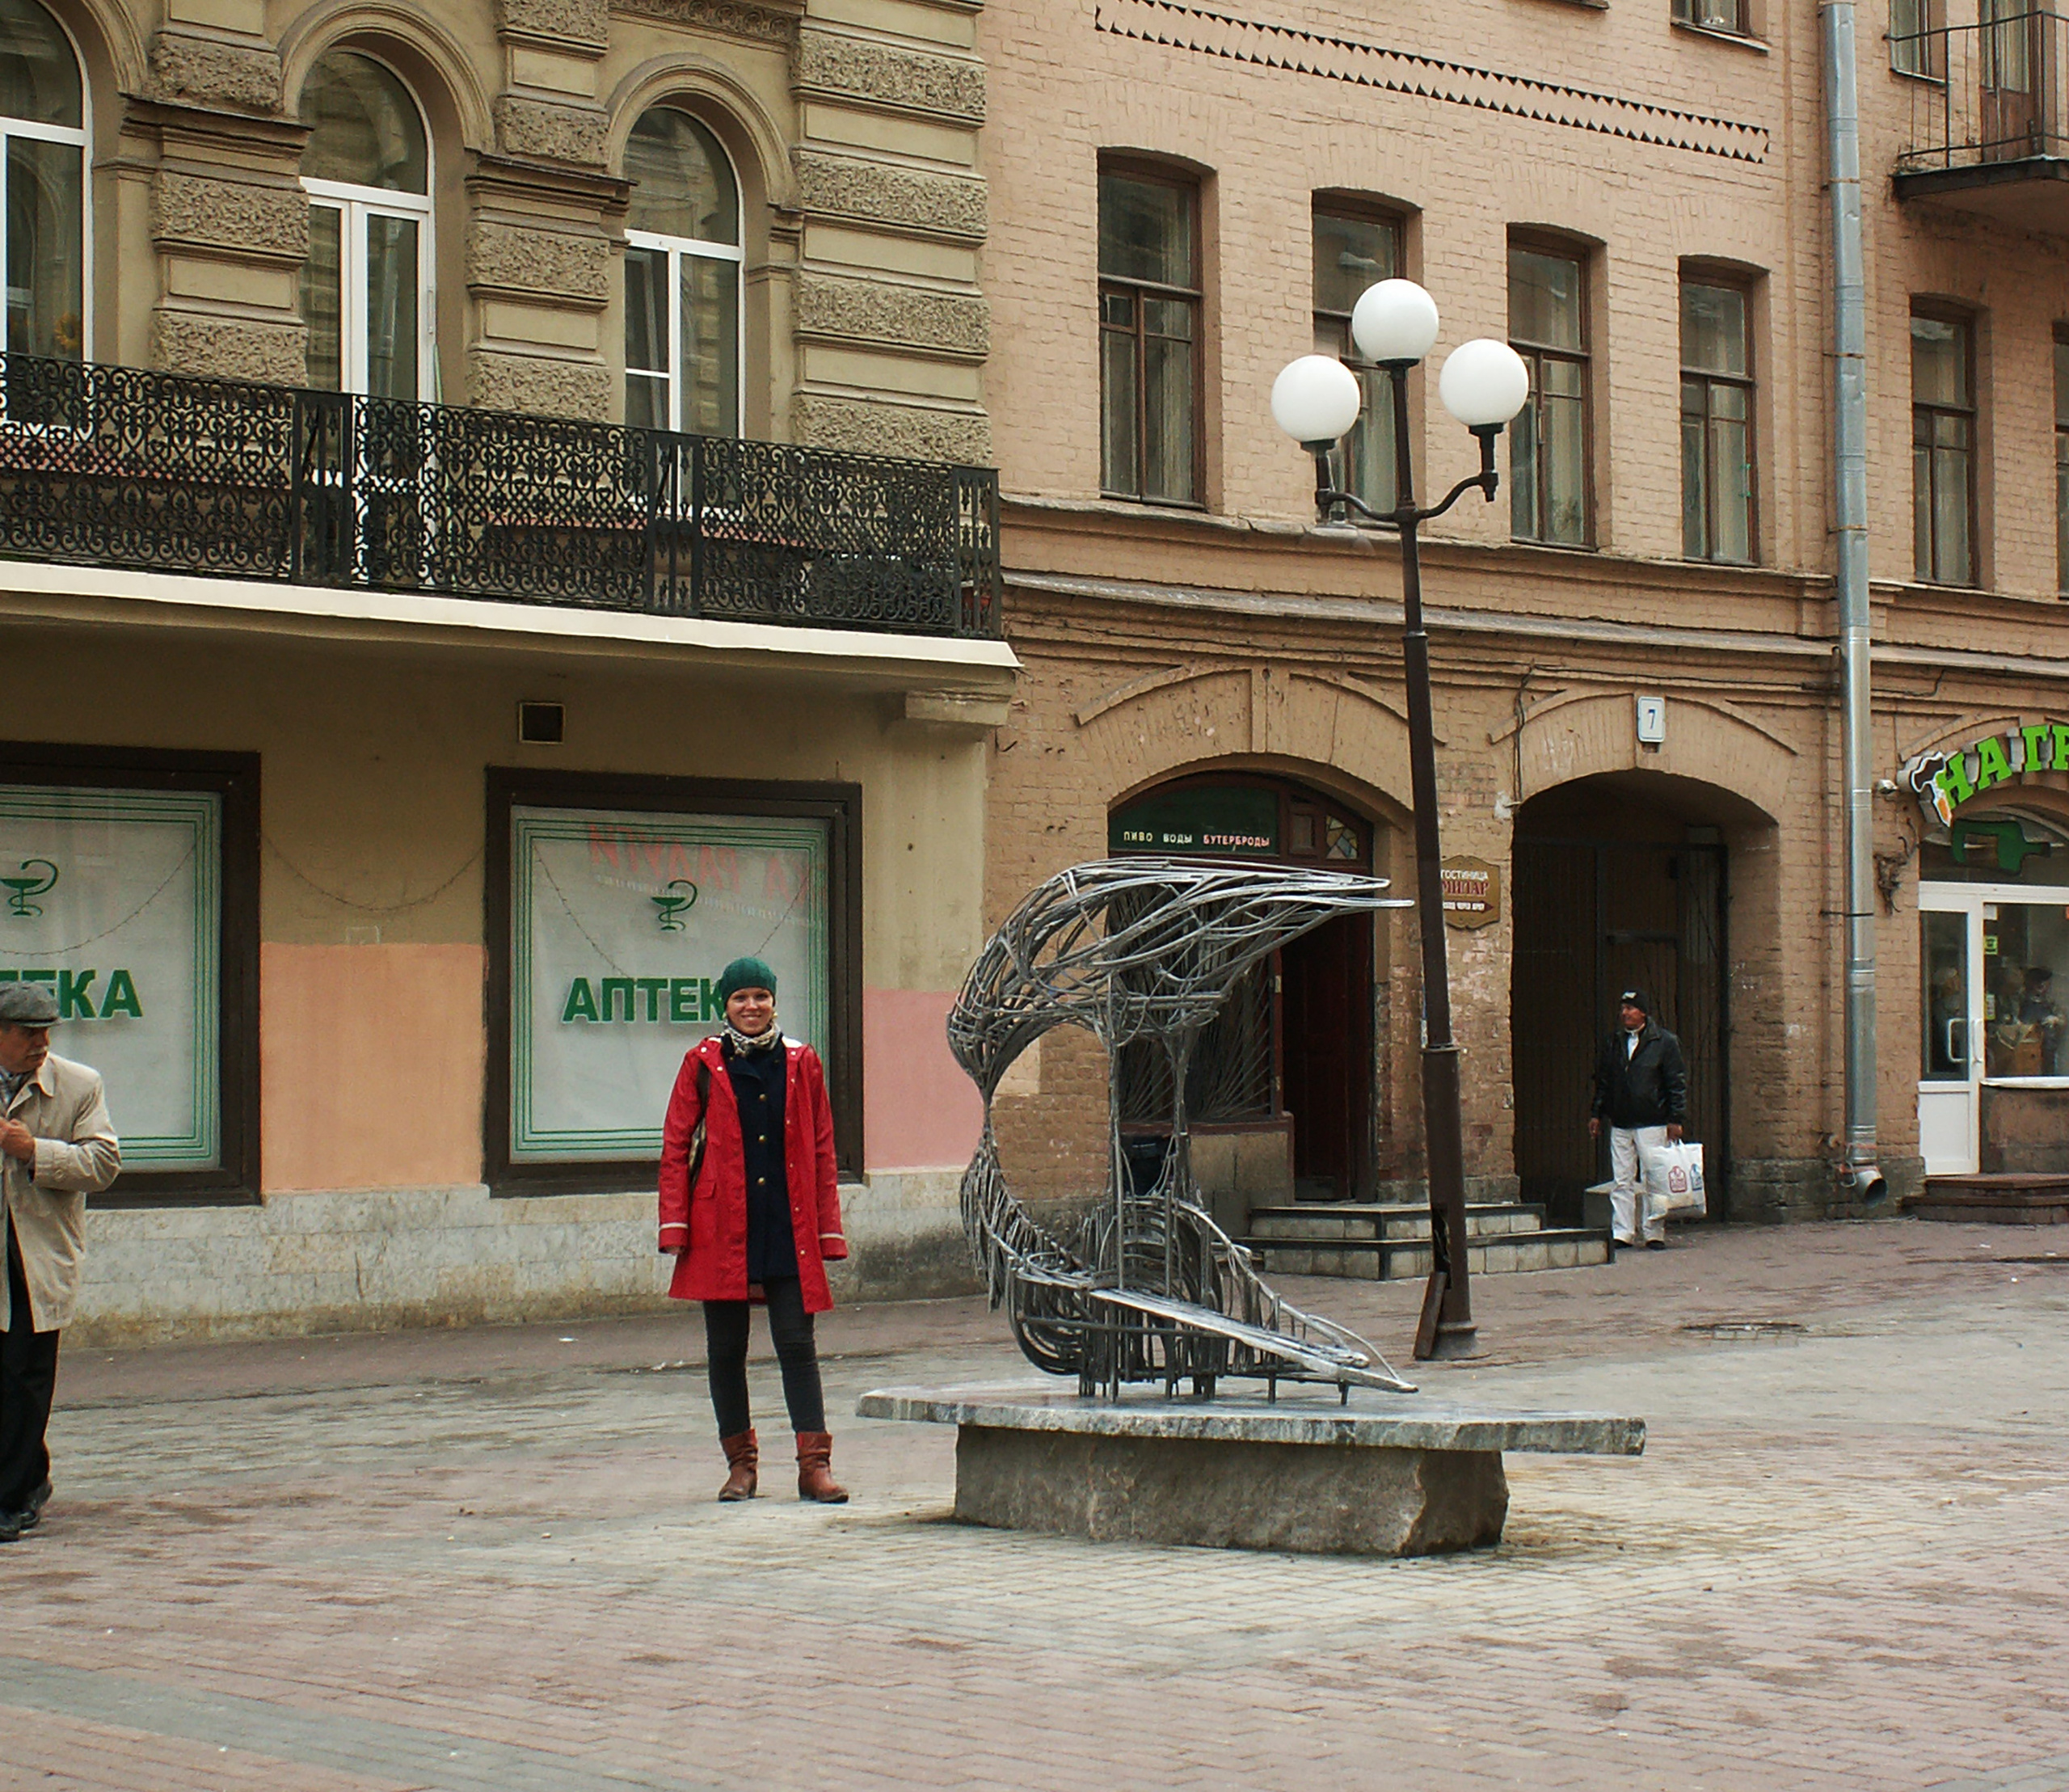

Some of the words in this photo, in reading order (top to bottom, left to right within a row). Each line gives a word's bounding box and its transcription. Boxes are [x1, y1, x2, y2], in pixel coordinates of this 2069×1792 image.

[1647, 708, 1656, 730] 7
[1123, 831, 1153, 842] ПИВО
[1163, 833, 1192, 845] ВОДЫ
[1203, 834, 1270, 847] БУТЕРБРОДЫ
[561, 977, 726, 1022] АПТЕК
